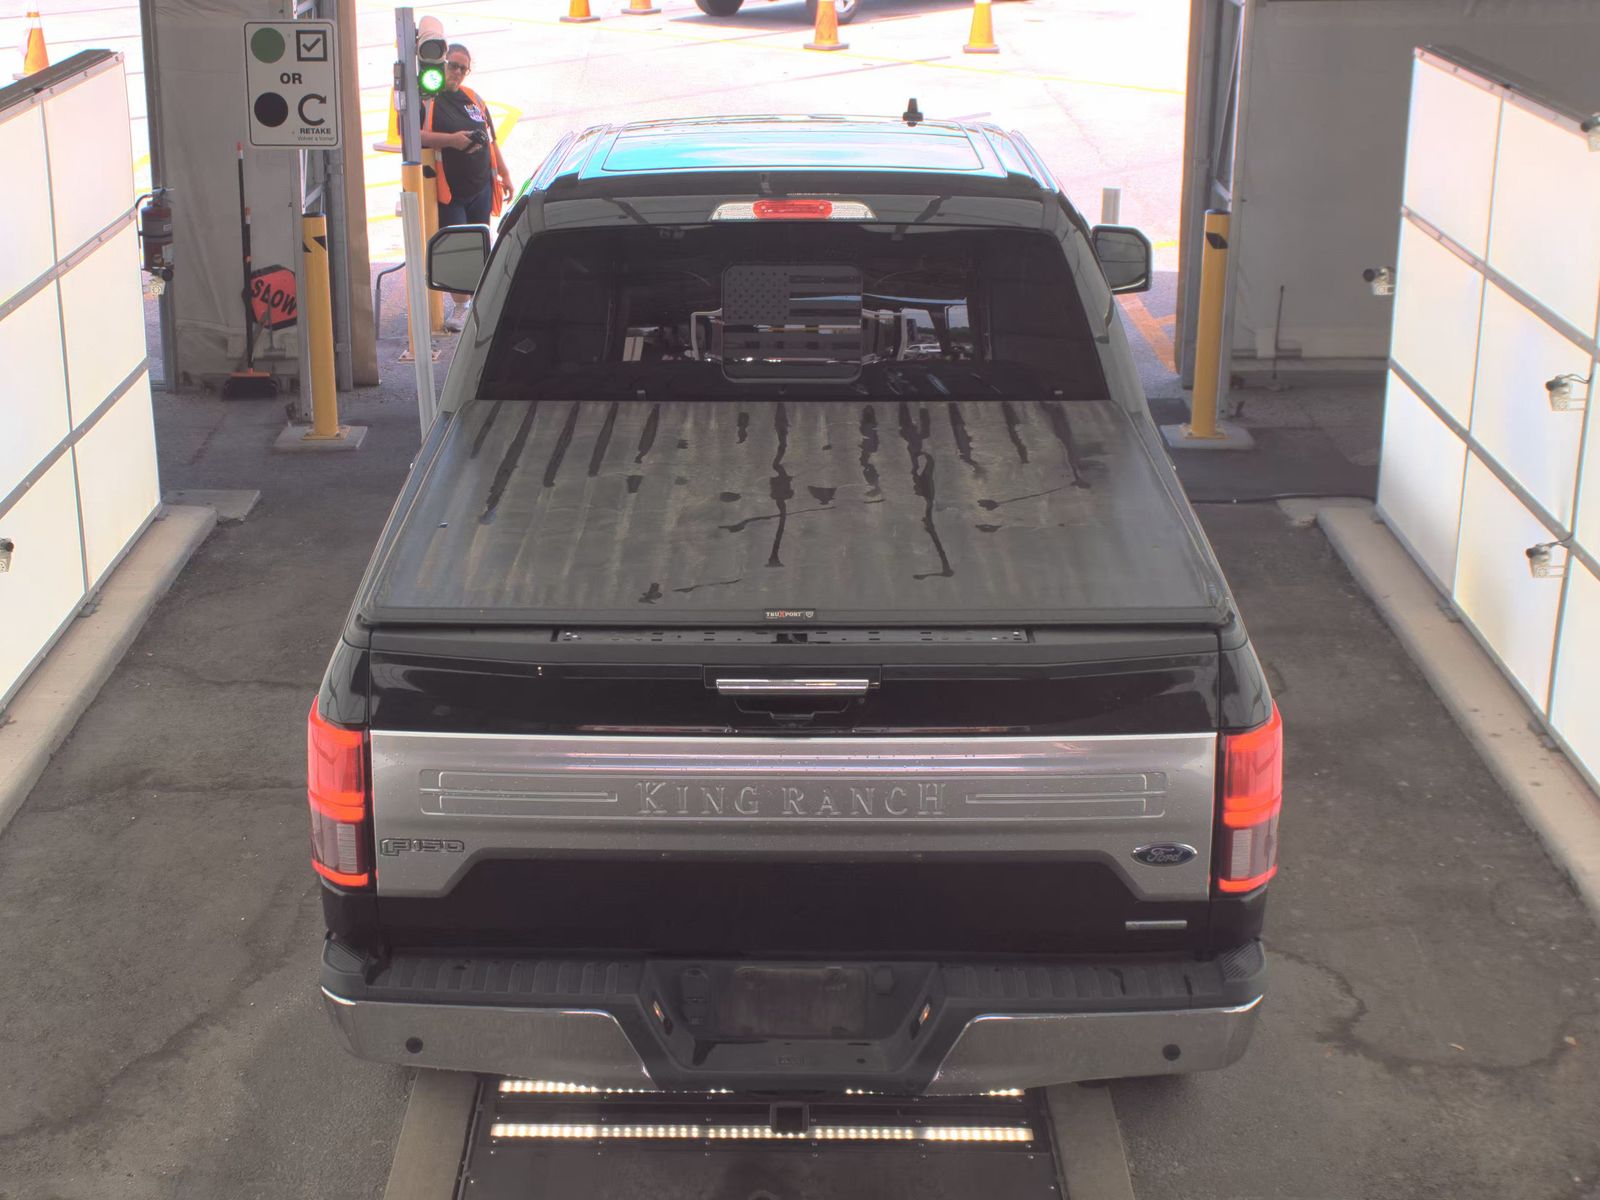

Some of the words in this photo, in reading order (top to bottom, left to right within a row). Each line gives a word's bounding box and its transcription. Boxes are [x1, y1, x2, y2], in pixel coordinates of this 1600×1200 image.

[280, 73, 302, 84] OR
[252, 279, 297, 315] SLOW
[635, 782, 759, 815] KING
[782, 783, 946, 816] RANCH
[1146, 847, 1183, 862] Ford
